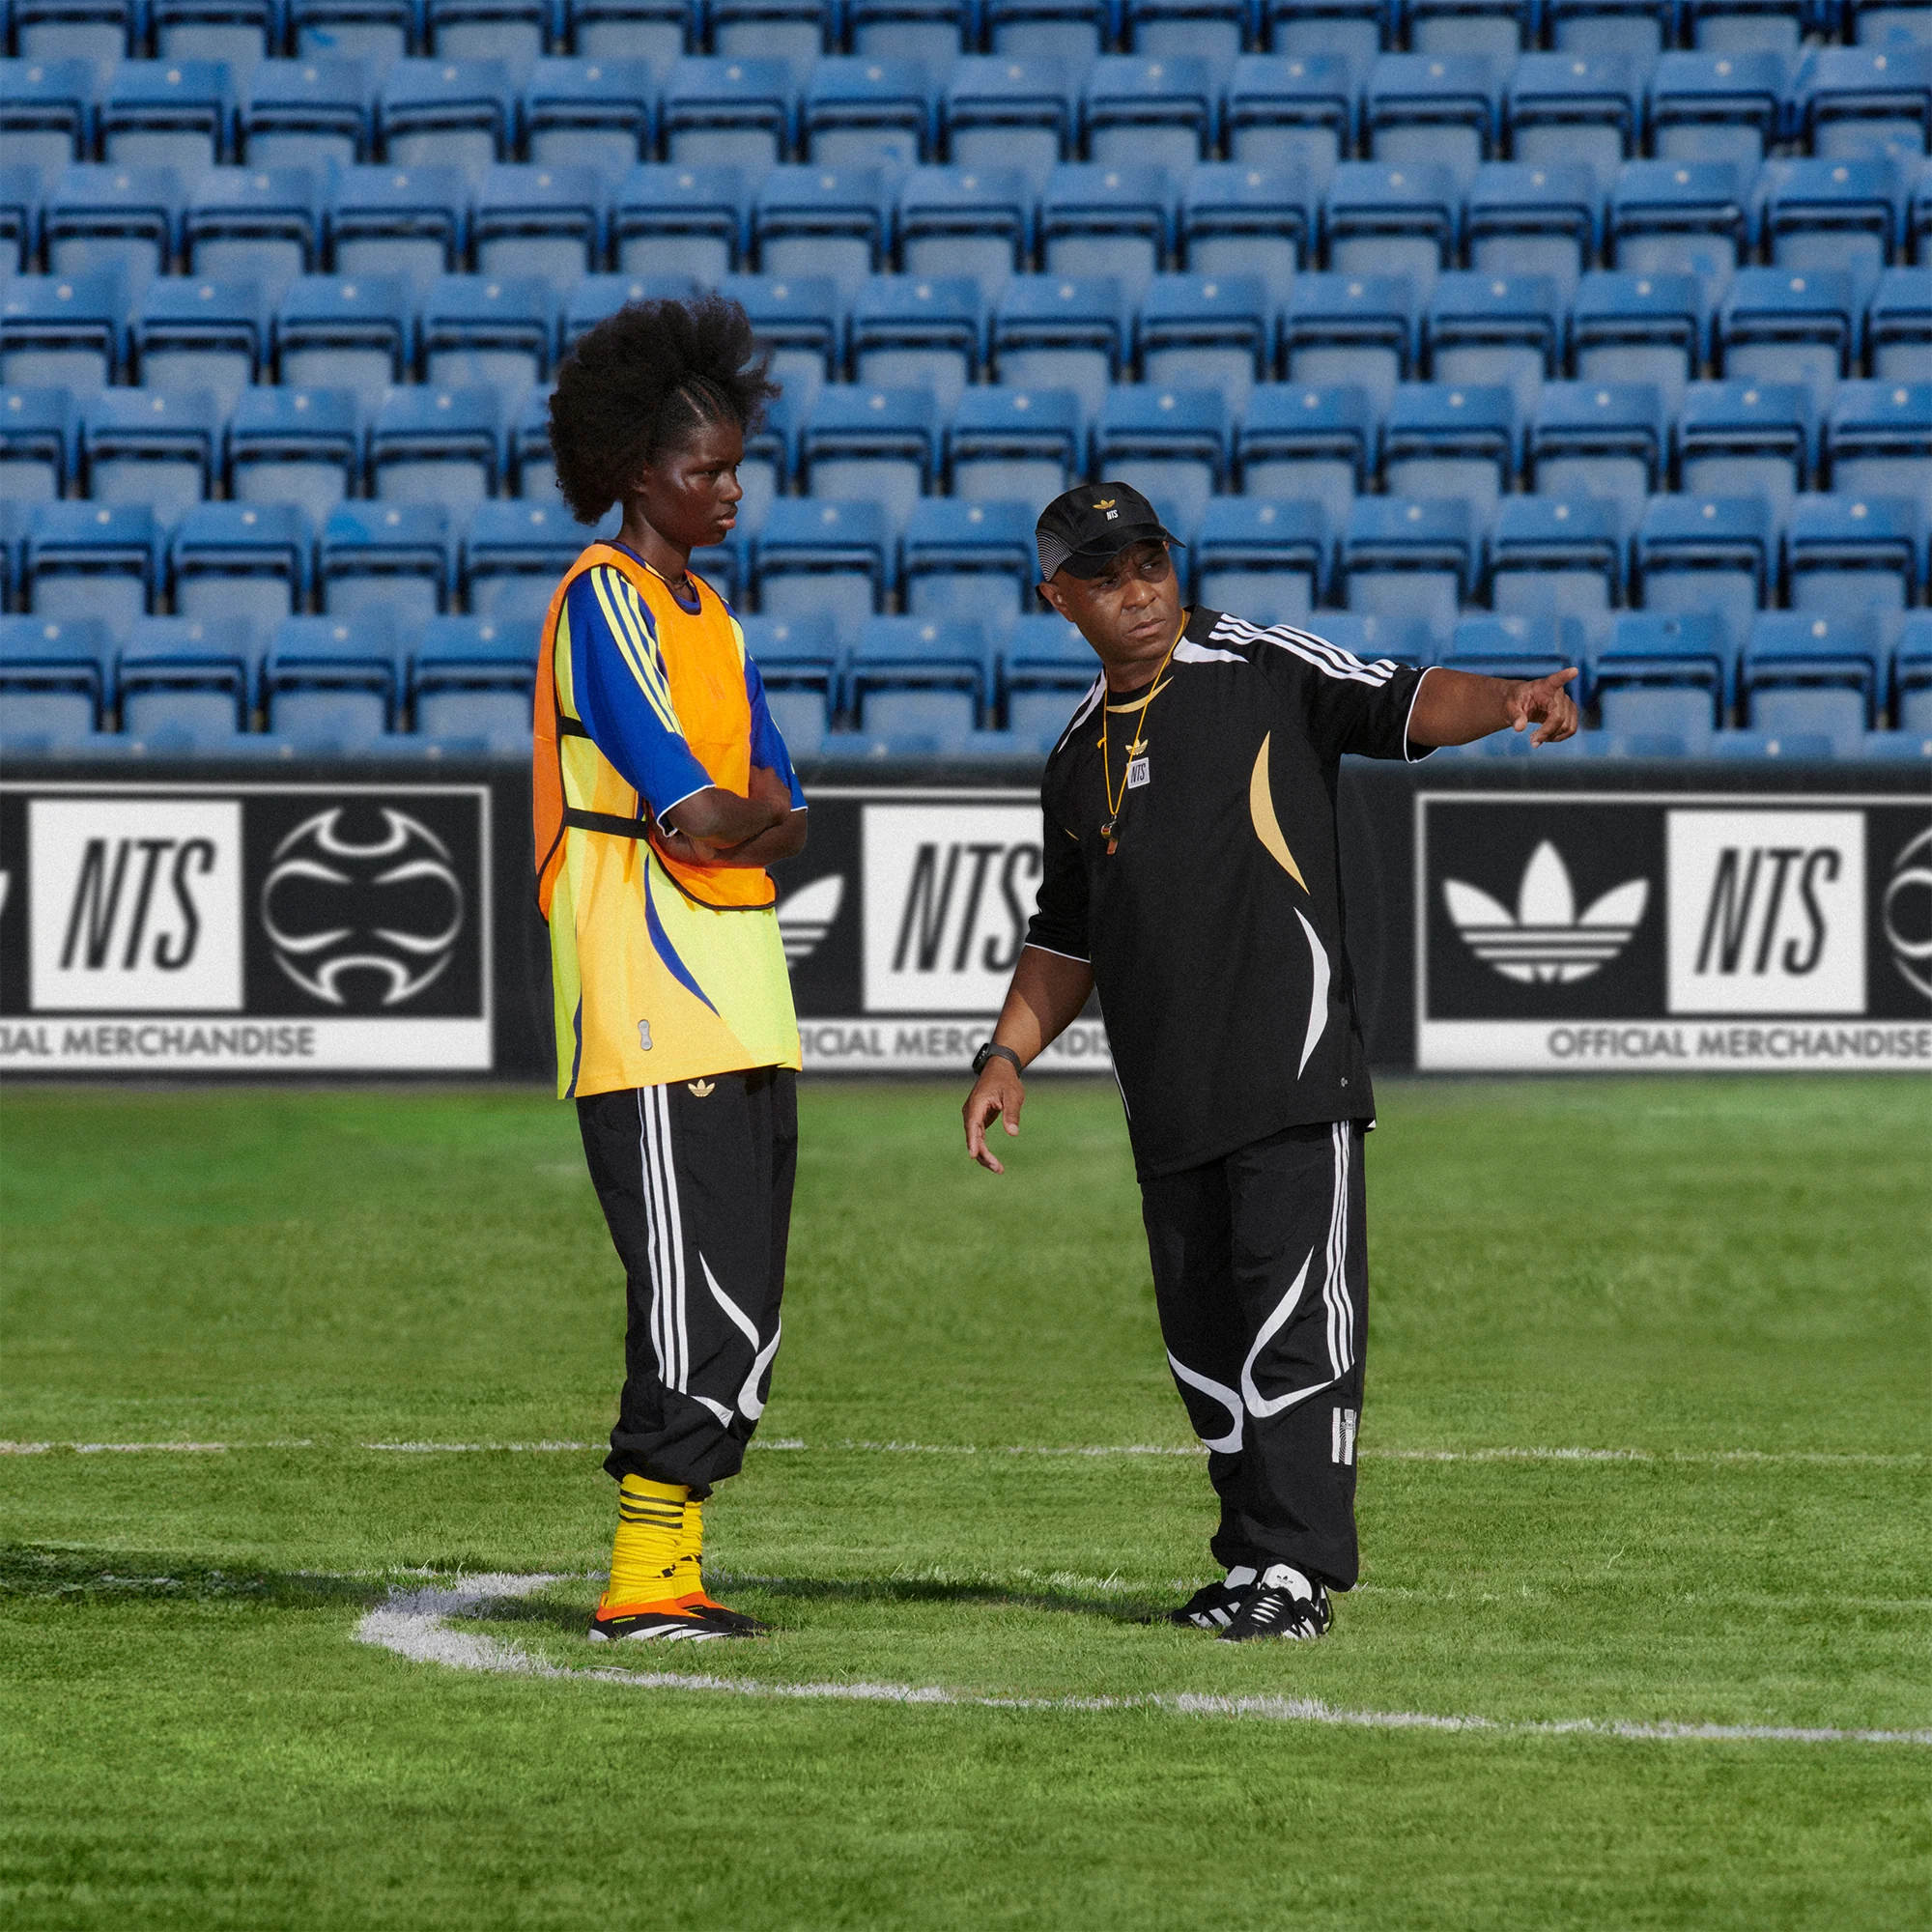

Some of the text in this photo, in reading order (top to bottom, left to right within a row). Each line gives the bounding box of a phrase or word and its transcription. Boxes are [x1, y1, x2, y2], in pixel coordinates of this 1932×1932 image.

[1106, 509, 1119, 521] NTS
[1130, 762, 1147, 783] NTS
[60, 838, 215, 971] NTS
[892, 842, 1042, 973] NTS
[1693, 847, 1842, 976] NTS
[62, 1026, 315, 1057] MERCHANDISE
[1548, 1027, 1931, 1060] OFFICIAL MERCHANDISE
